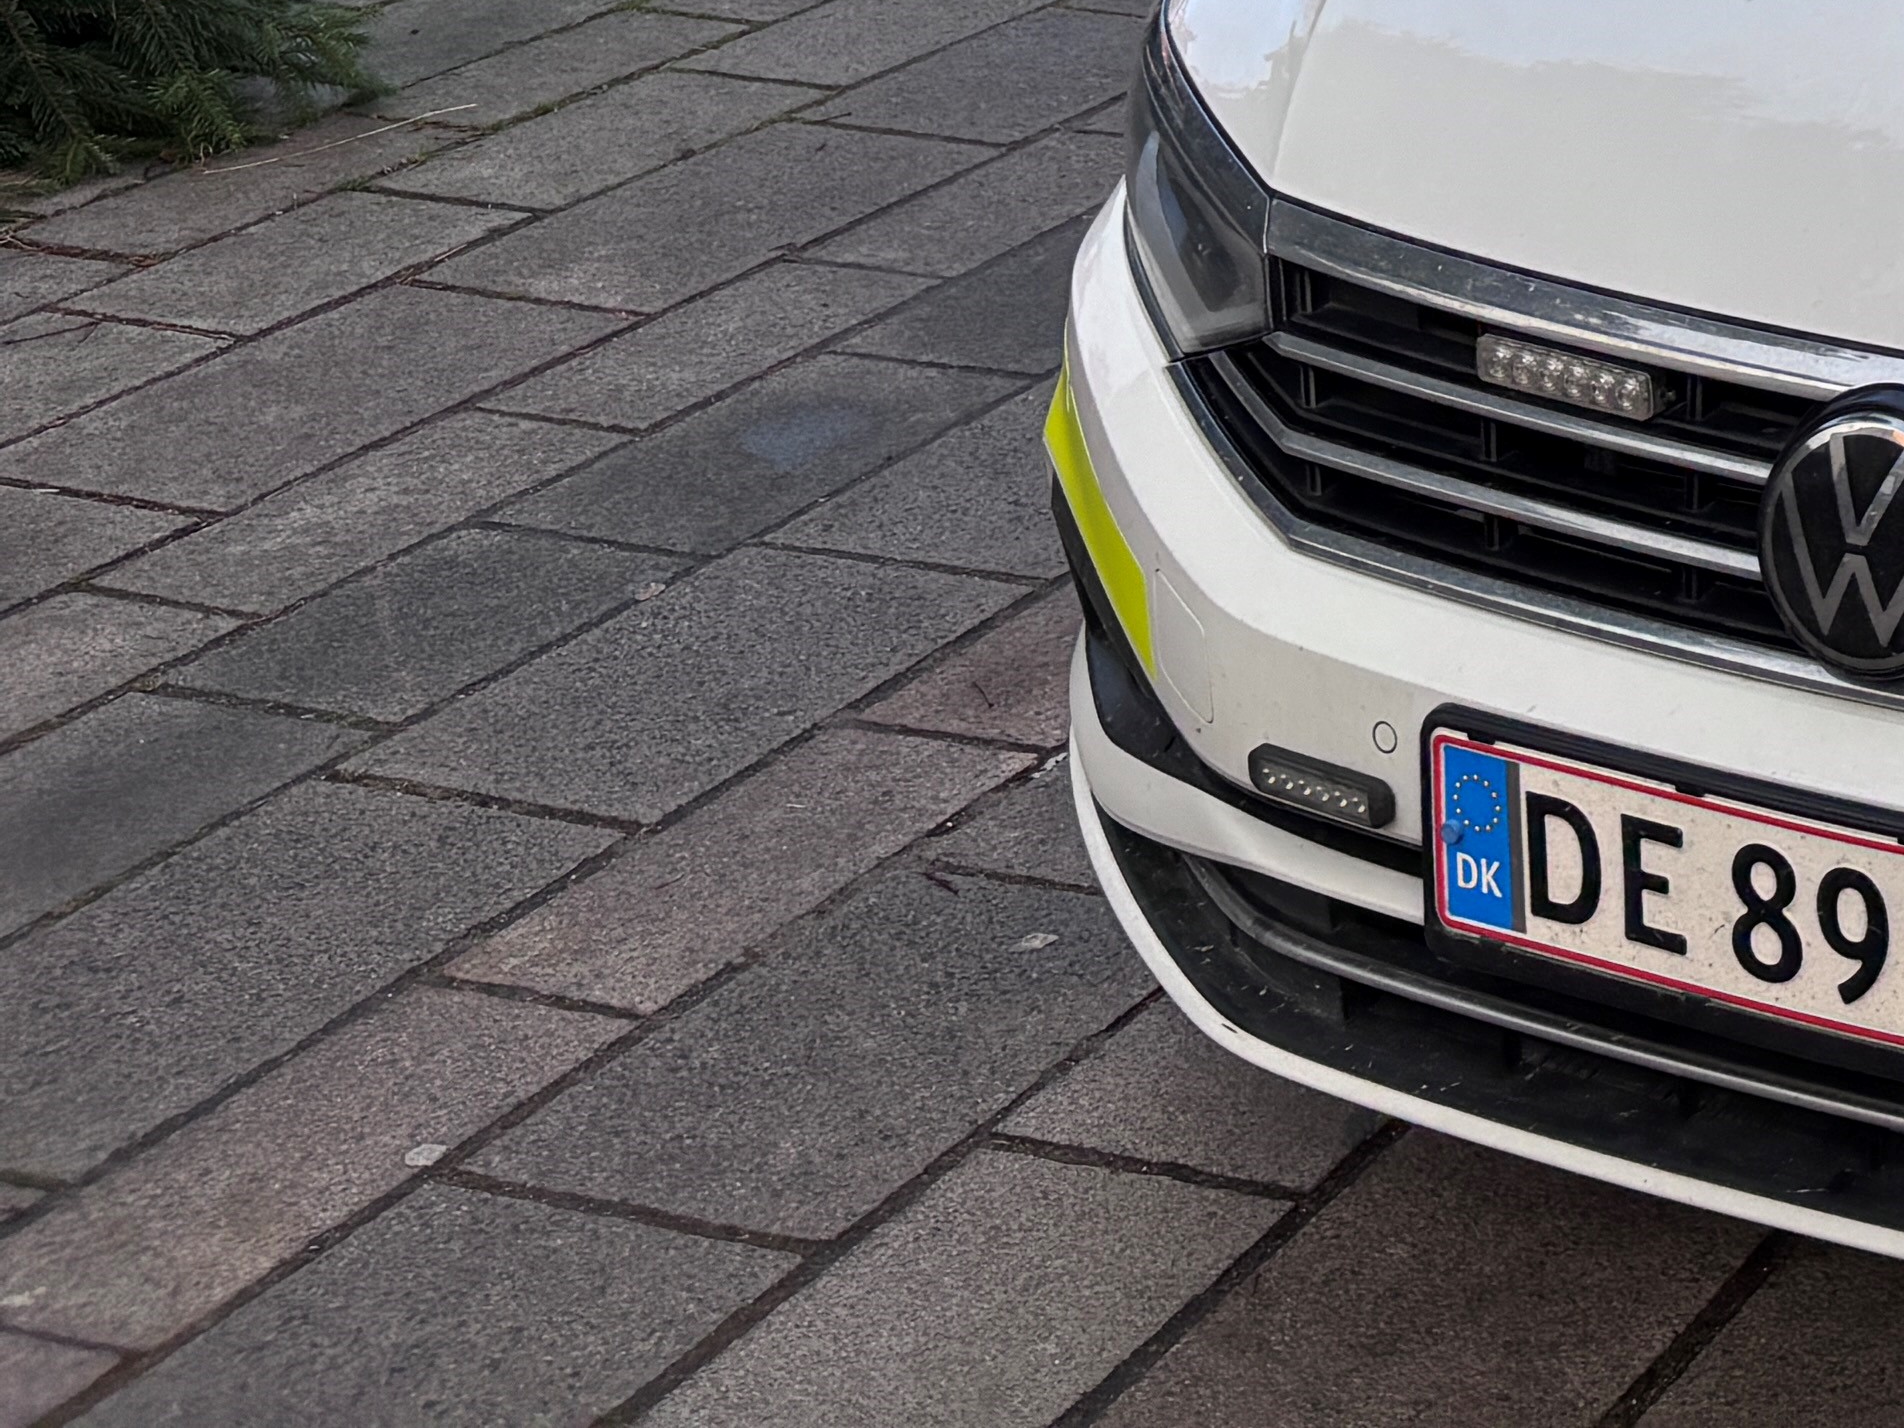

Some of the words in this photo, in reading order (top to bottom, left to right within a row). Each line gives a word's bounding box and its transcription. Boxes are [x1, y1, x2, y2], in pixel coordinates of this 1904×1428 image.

[1455, 852, 1503, 899] DK
[1524, 790, 1688, 956] DE
[1731, 842, 1890, 1005] 89
